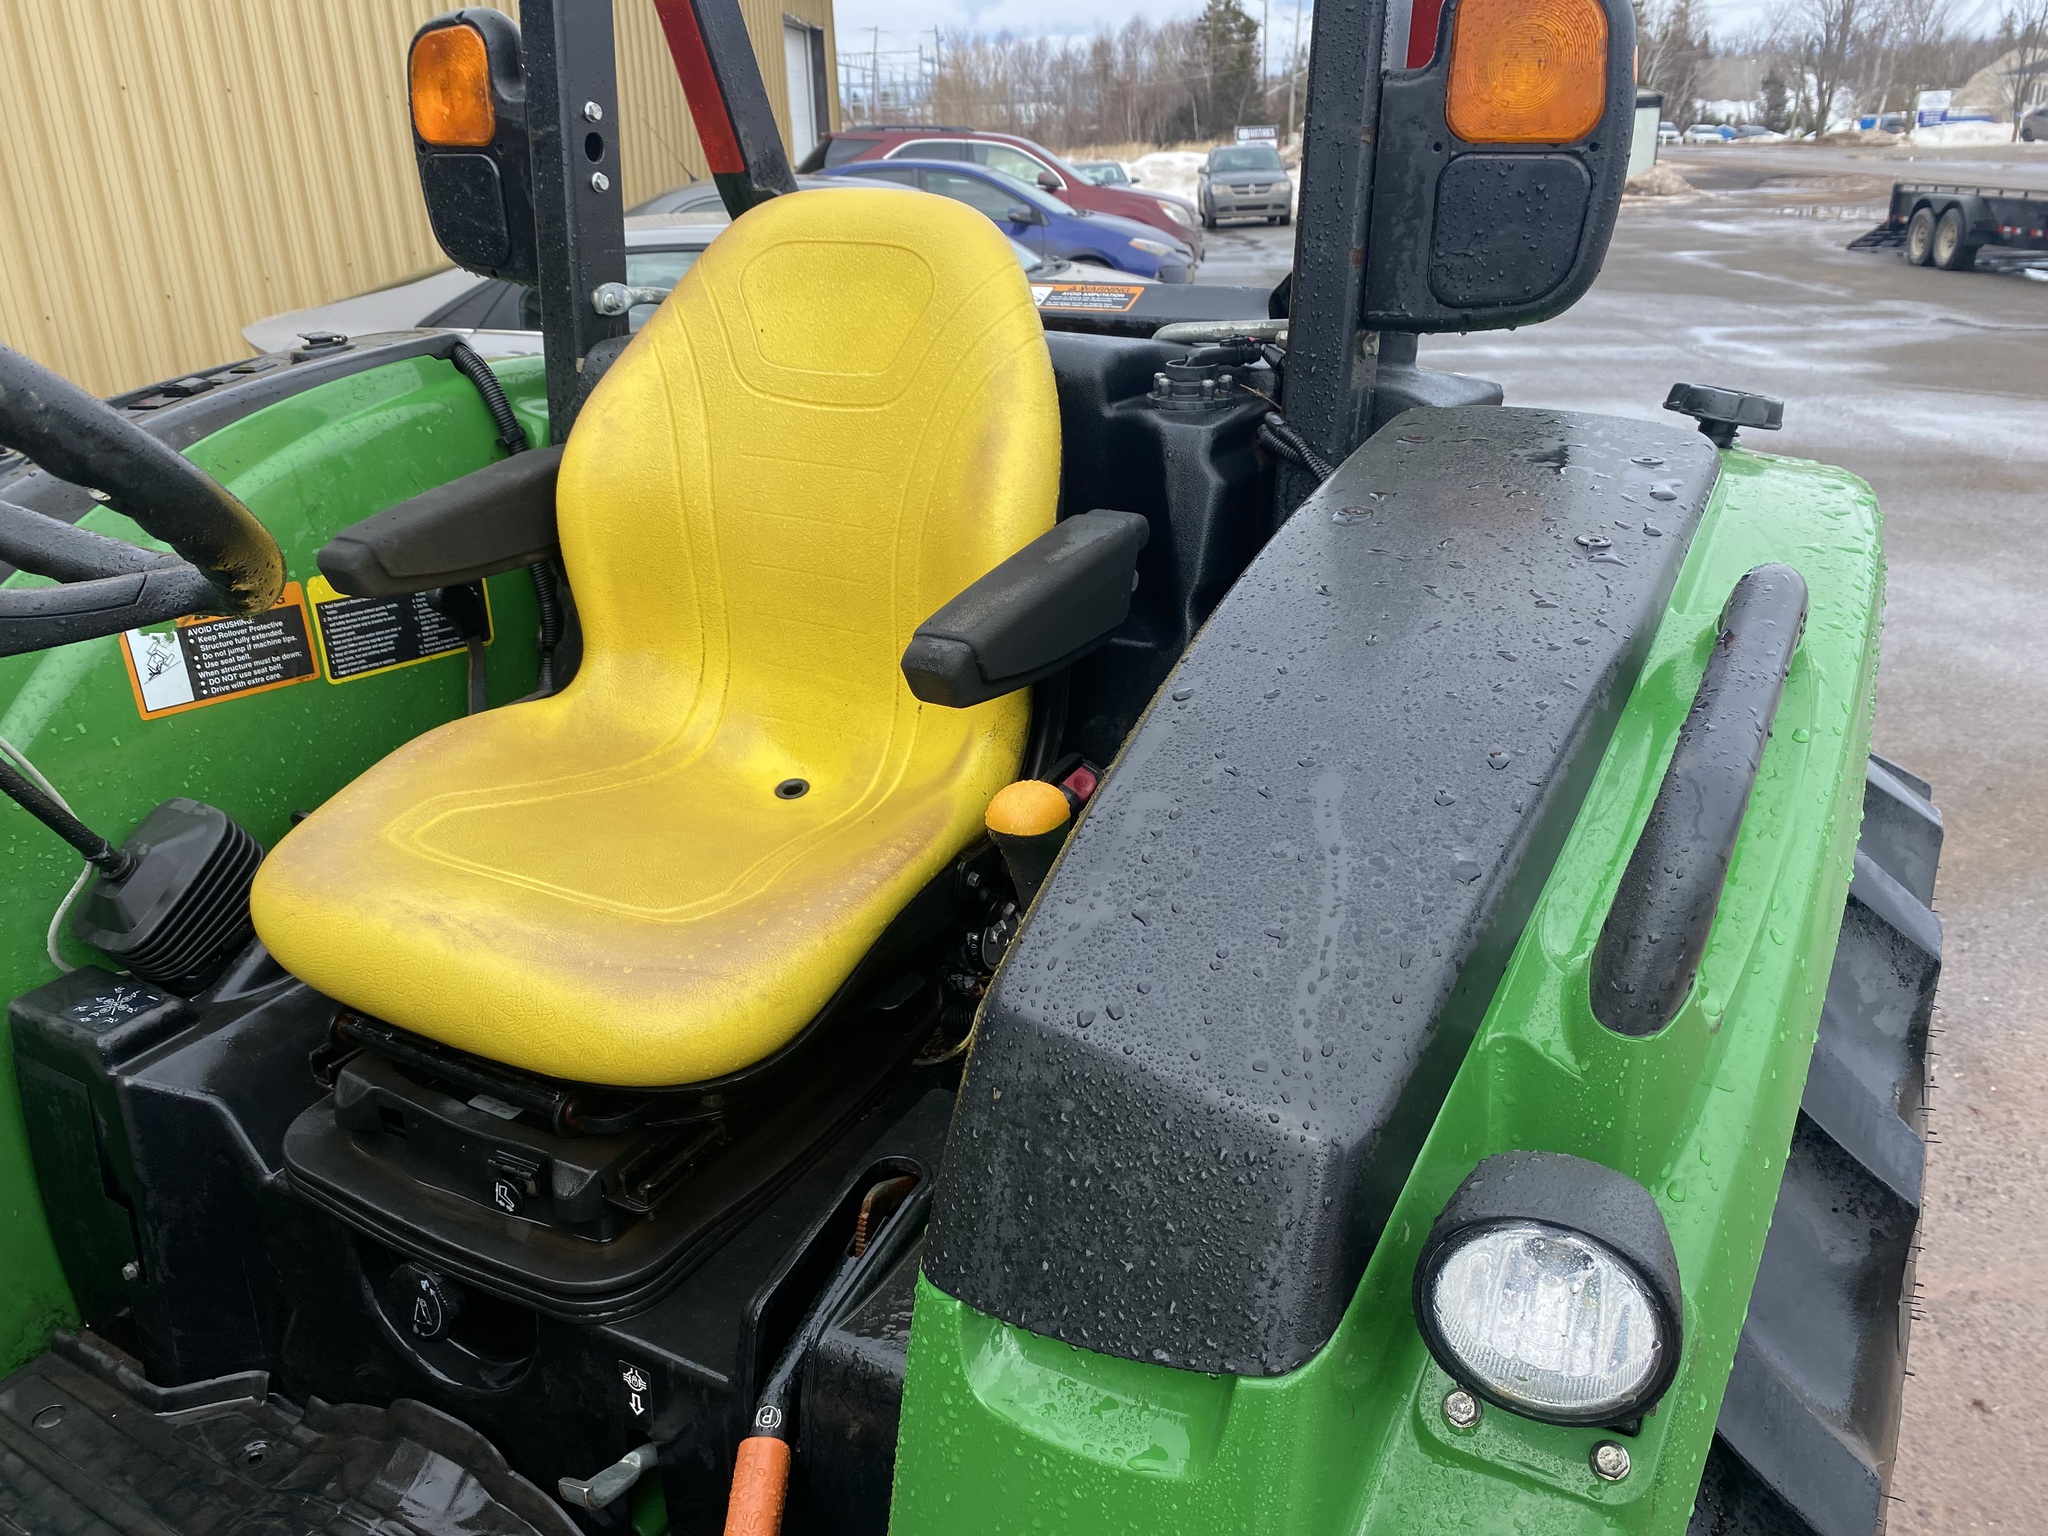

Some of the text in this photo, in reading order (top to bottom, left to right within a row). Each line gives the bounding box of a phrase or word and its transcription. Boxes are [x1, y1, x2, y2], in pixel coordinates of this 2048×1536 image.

[187, 625, 212, 637] AVOID
[198, 620, 284, 644] Keep Rollover Protective
[200, 628, 285, 652] Structure fully extended.
[202, 634, 298, 660] Do not jump if machine tips.
[198, 669, 220, 679] When
[221, 662, 253, 674] structure
[253, 658, 271, 667] must
[272, 654, 281, 662] be
[204, 653, 252, 669] Use seat belt.
[208, 663, 284, 686] DO NOT use seat belt.
[210, 684, 230, 694] Drive
[231, 679, 247, 689] with
[247, 676, 265, 685] extra
[265, 672, 283, 681] care.
